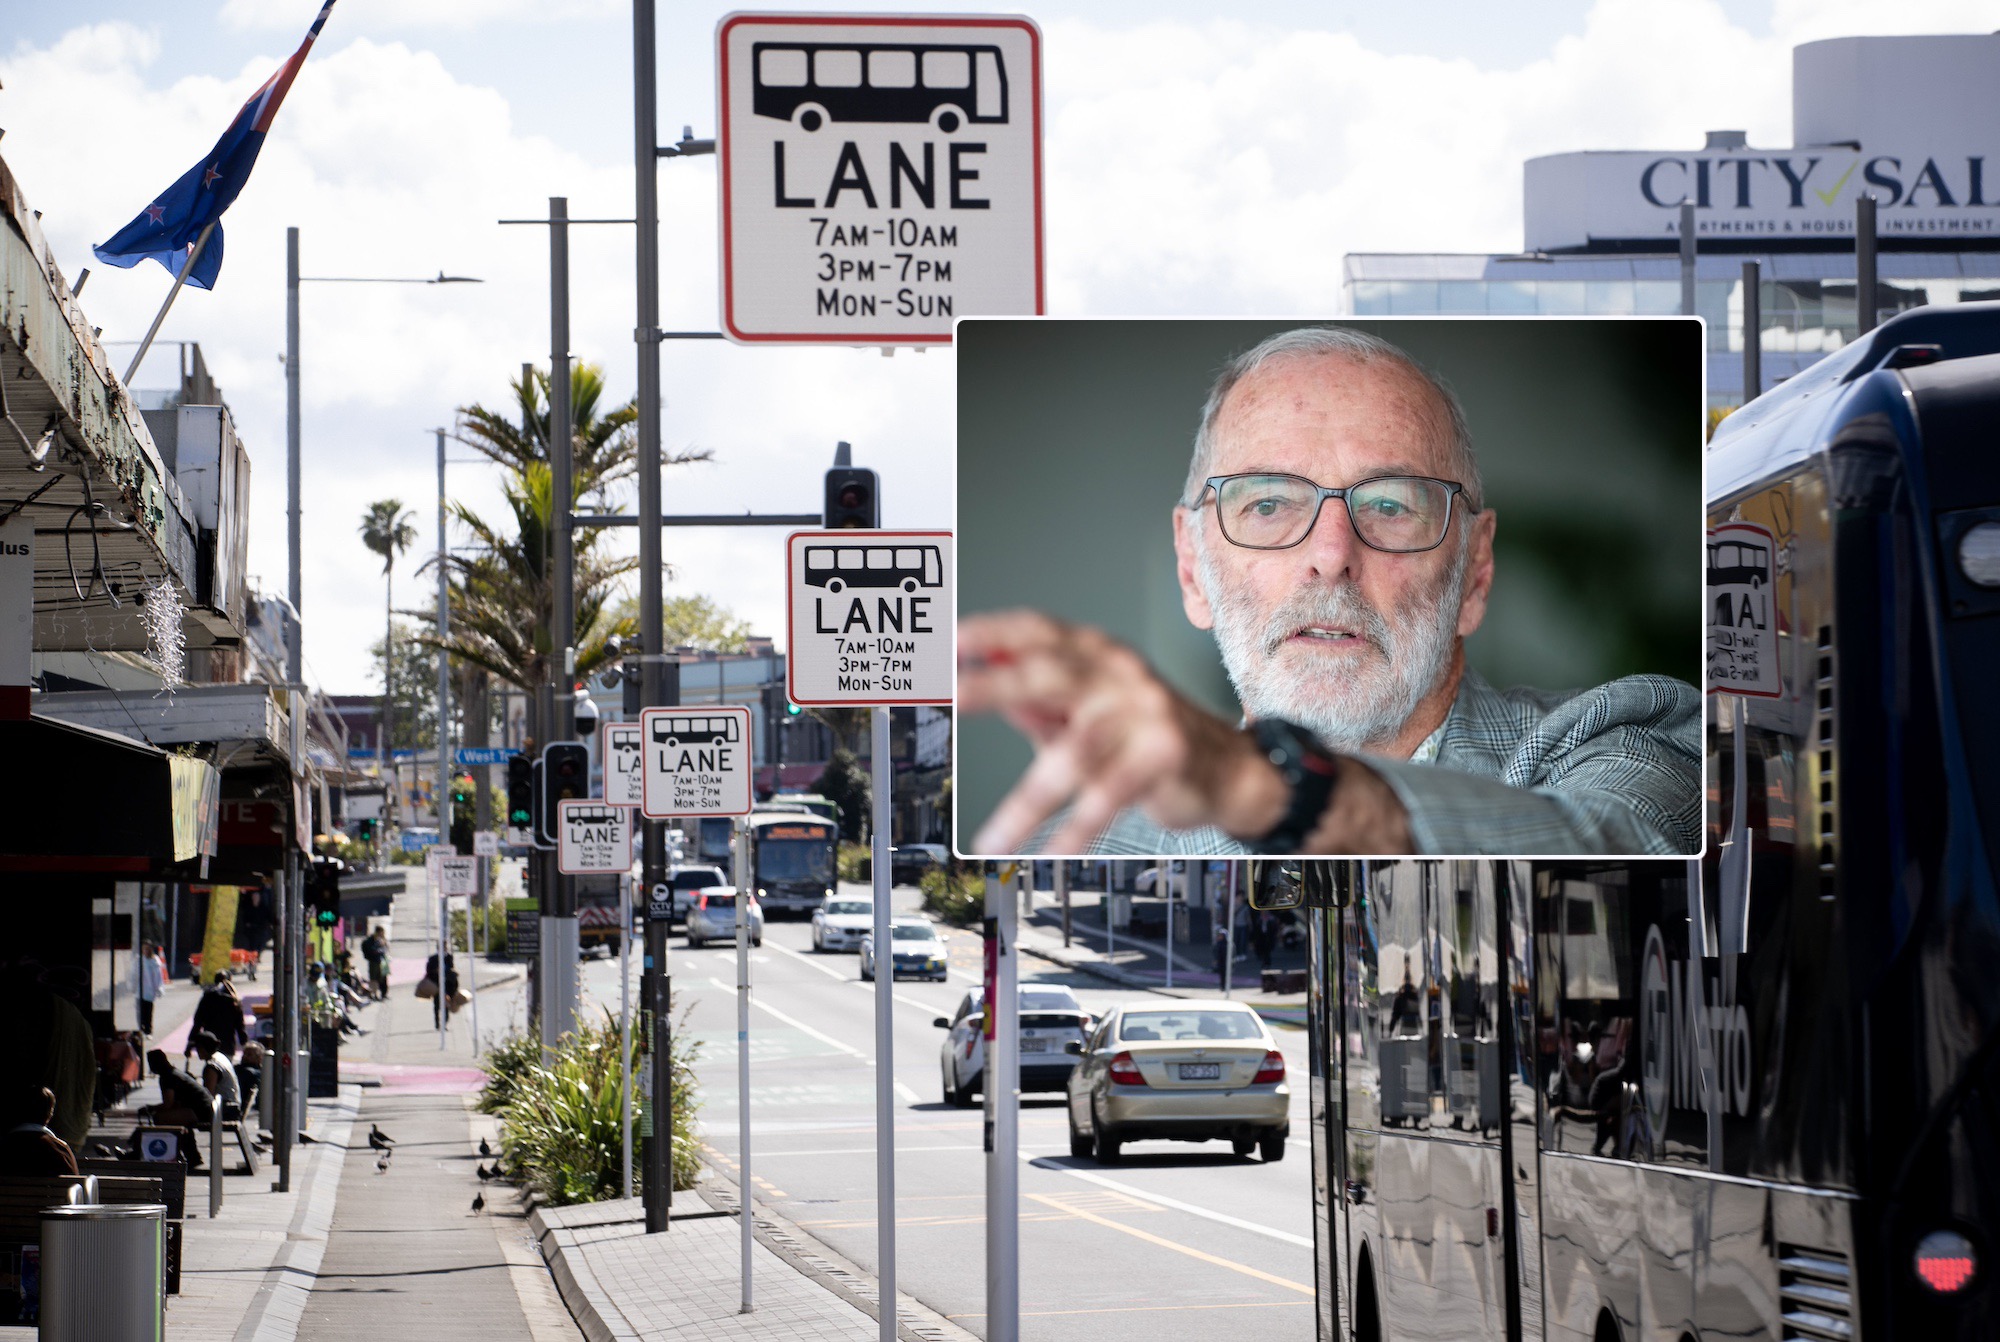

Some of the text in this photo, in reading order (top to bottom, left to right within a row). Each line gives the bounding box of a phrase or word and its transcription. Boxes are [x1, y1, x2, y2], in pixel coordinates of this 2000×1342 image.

[774, 140, 990, 209] LANE
[1640, 157, 1822, 209] CITY
[809, 218, 957, 247] 7AM-10AM
[1665, 220, 1776, 232] ARTMENTS
[1783, 221, 1793, 232] &
[817, 253, 952, 281] 3PM-7PM
[816, 597, 933, 634] LANE
[835, 638, 915, 654] 7AM-10AM
[838, 657, 912, 672] 3PM-7PM
[463, 750, 495, 762] West
[660, 749, 733, 773] LANE
[672, 775, 722, 785] 7AM-10AM
[674, 787, 720, 797] 3PM-7PM
[571, 828, 620, 843] LANE
[445, 870, 470, 880] LANE
[650, 901, 671, 910] CCTV
